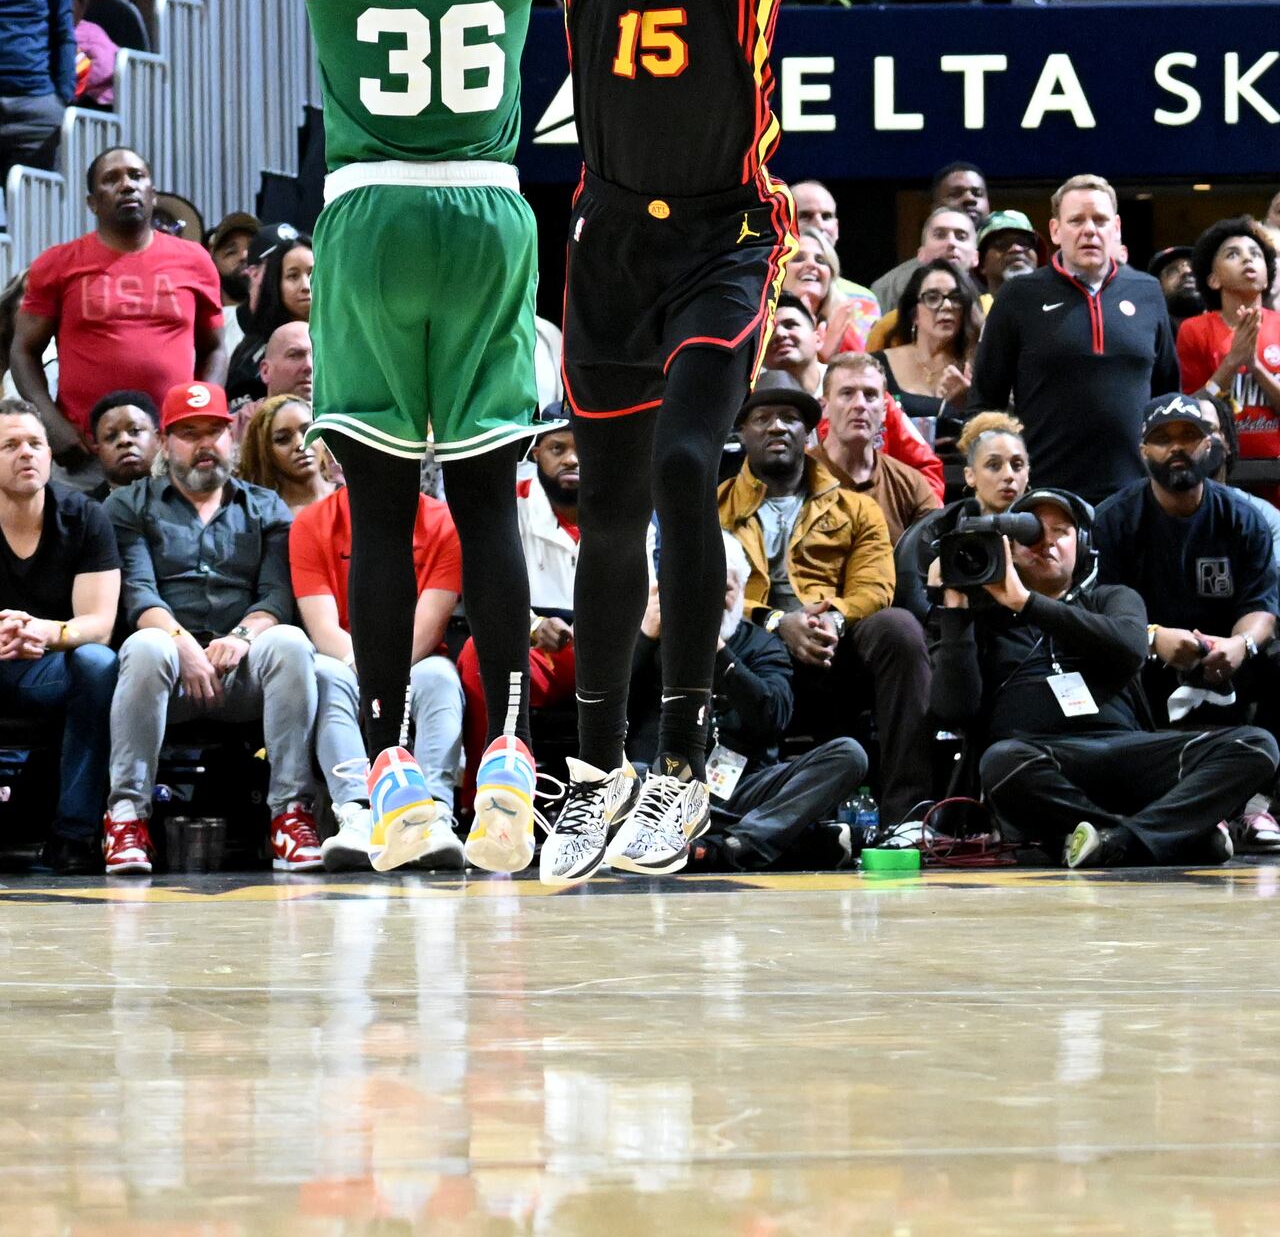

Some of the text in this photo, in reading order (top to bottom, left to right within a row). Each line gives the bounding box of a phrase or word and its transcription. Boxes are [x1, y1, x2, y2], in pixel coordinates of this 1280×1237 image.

[356, 0, 506, 117] 36
[612, 7, 690, 80] 15
[781, 52, 1097, 132] ELTA
[80, 274, 183, 323] USA
